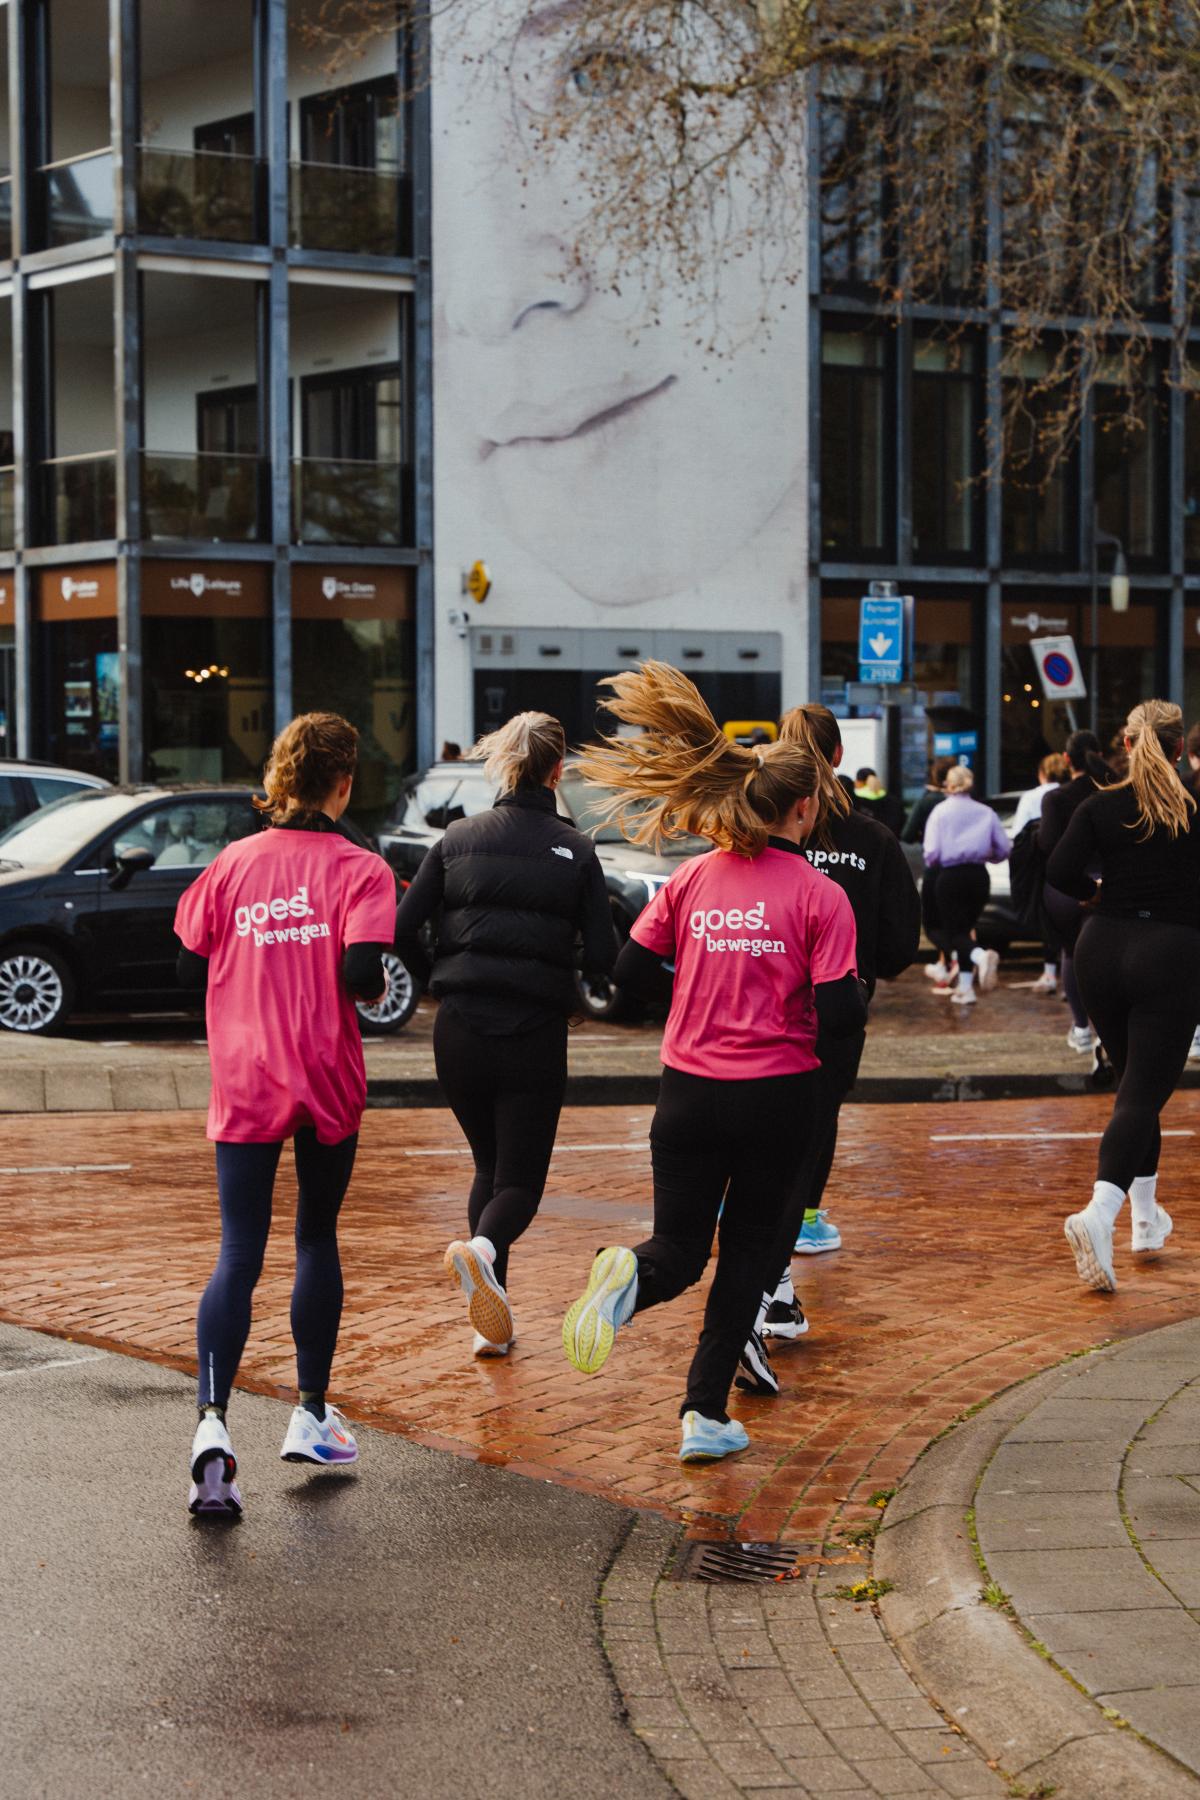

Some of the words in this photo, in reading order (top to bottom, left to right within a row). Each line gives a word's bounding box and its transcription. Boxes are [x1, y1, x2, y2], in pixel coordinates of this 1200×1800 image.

[806, 850, 866, 871] sports
[252, 921, 331, 948] bewegen
[705, 933, 786, 957] bewegen
